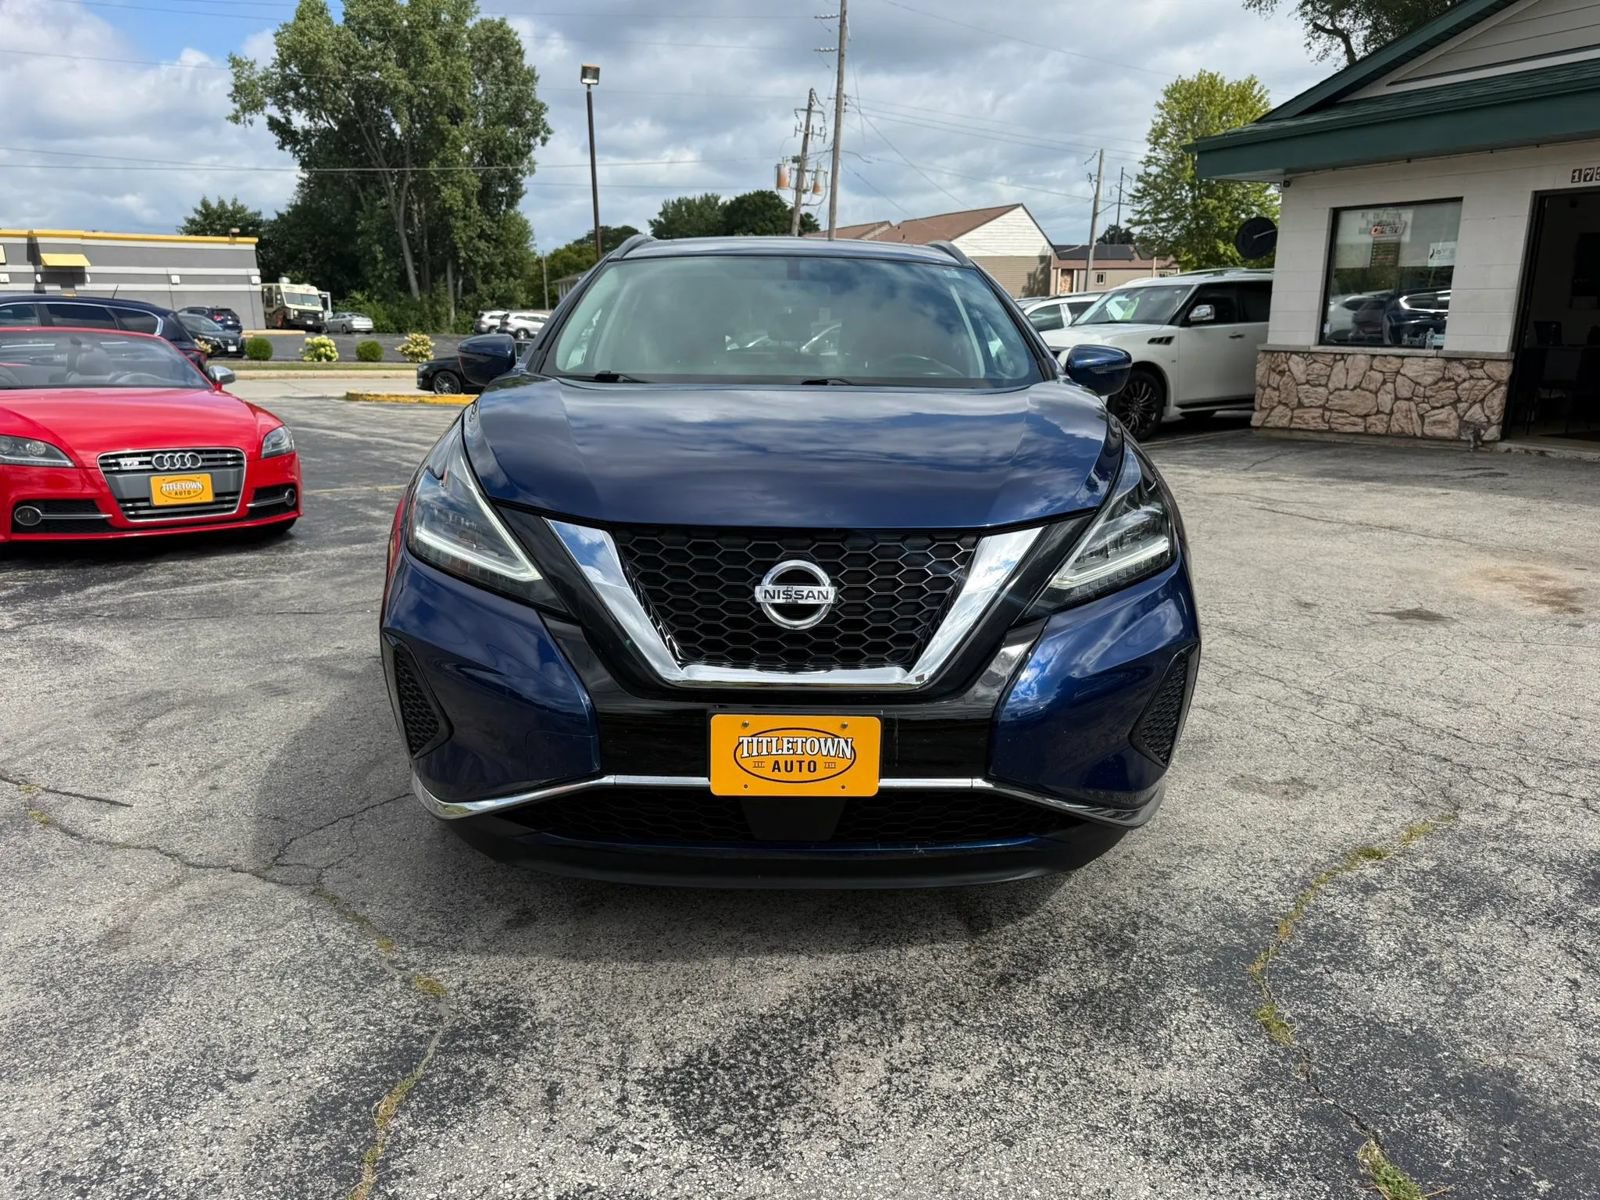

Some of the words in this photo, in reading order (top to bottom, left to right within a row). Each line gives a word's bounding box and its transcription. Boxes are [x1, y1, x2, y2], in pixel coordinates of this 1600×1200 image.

[763, 589, 829, 600] NISSAN
[738, 735, 853, 760] TITLETOWN
[771, 759, 817, 773] AUTO
